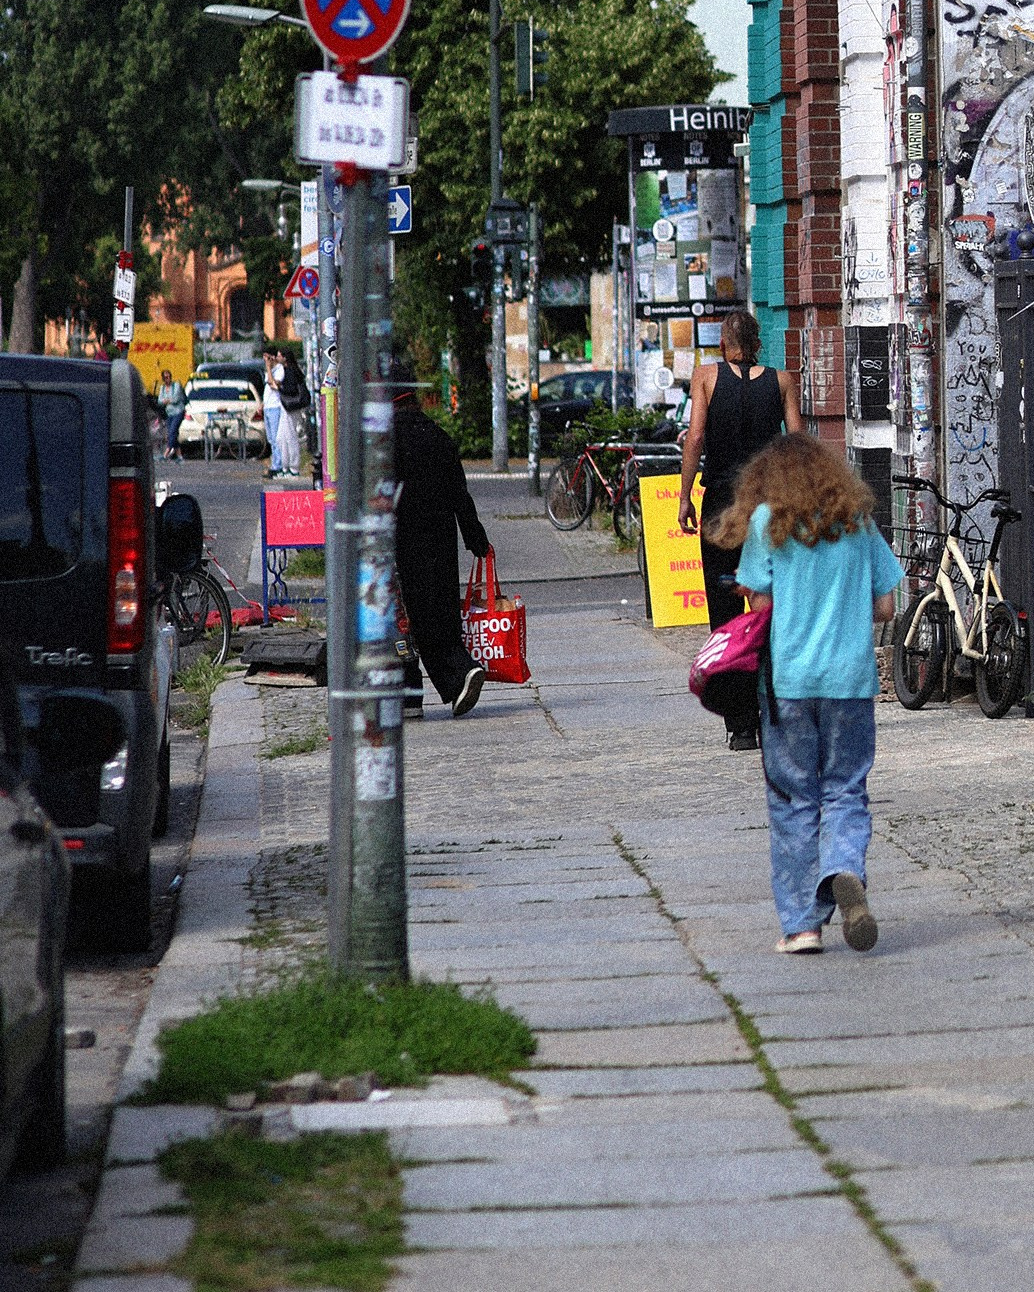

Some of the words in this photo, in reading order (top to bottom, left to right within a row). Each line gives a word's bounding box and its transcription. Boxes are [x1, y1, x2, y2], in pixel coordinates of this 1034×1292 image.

[908, 113, 923, 159] WARNING
[957, 339, 988, 356] YOU
[461, 618, 511, 635] AMPOO
